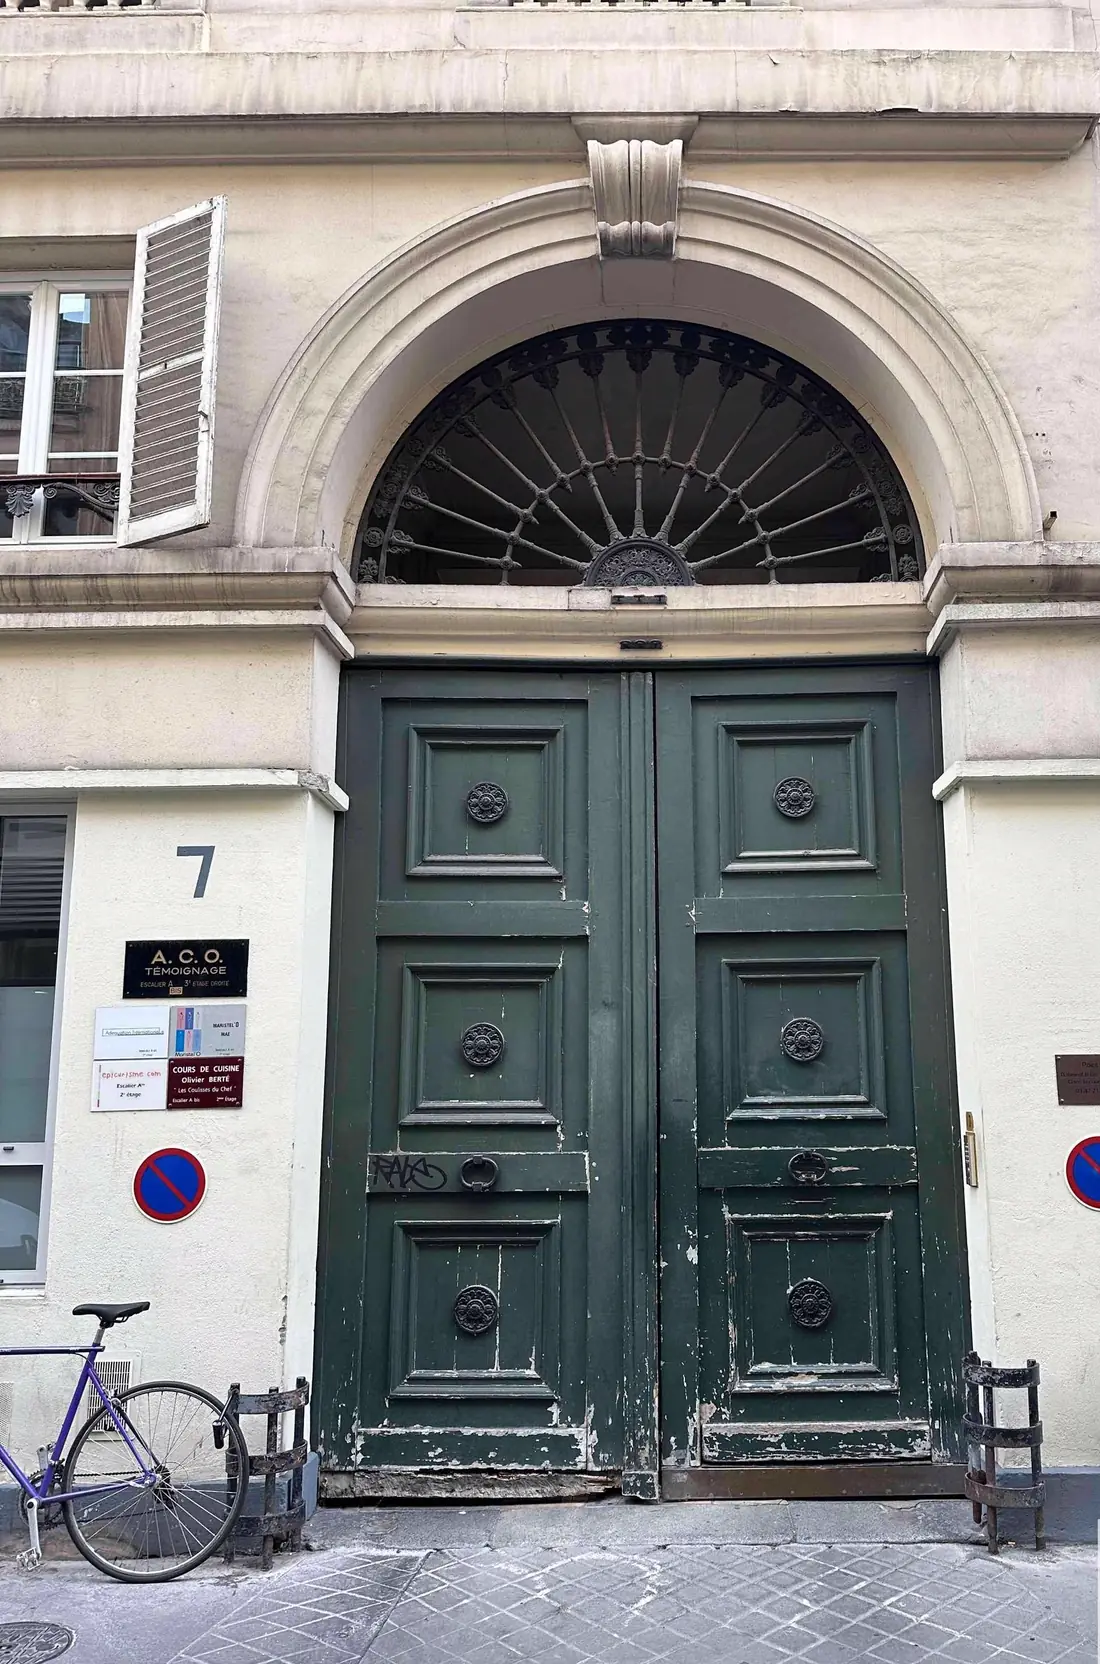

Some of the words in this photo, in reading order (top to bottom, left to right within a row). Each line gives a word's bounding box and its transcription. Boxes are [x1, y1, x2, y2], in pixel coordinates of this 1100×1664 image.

[177, 846, 215, 898] 7
[145, 966, 227, 976] TÉMOIGNAGE
[181, 1076, 205, 1084] Olivier
[208, 1075, 230, 1083] BERTÉ
